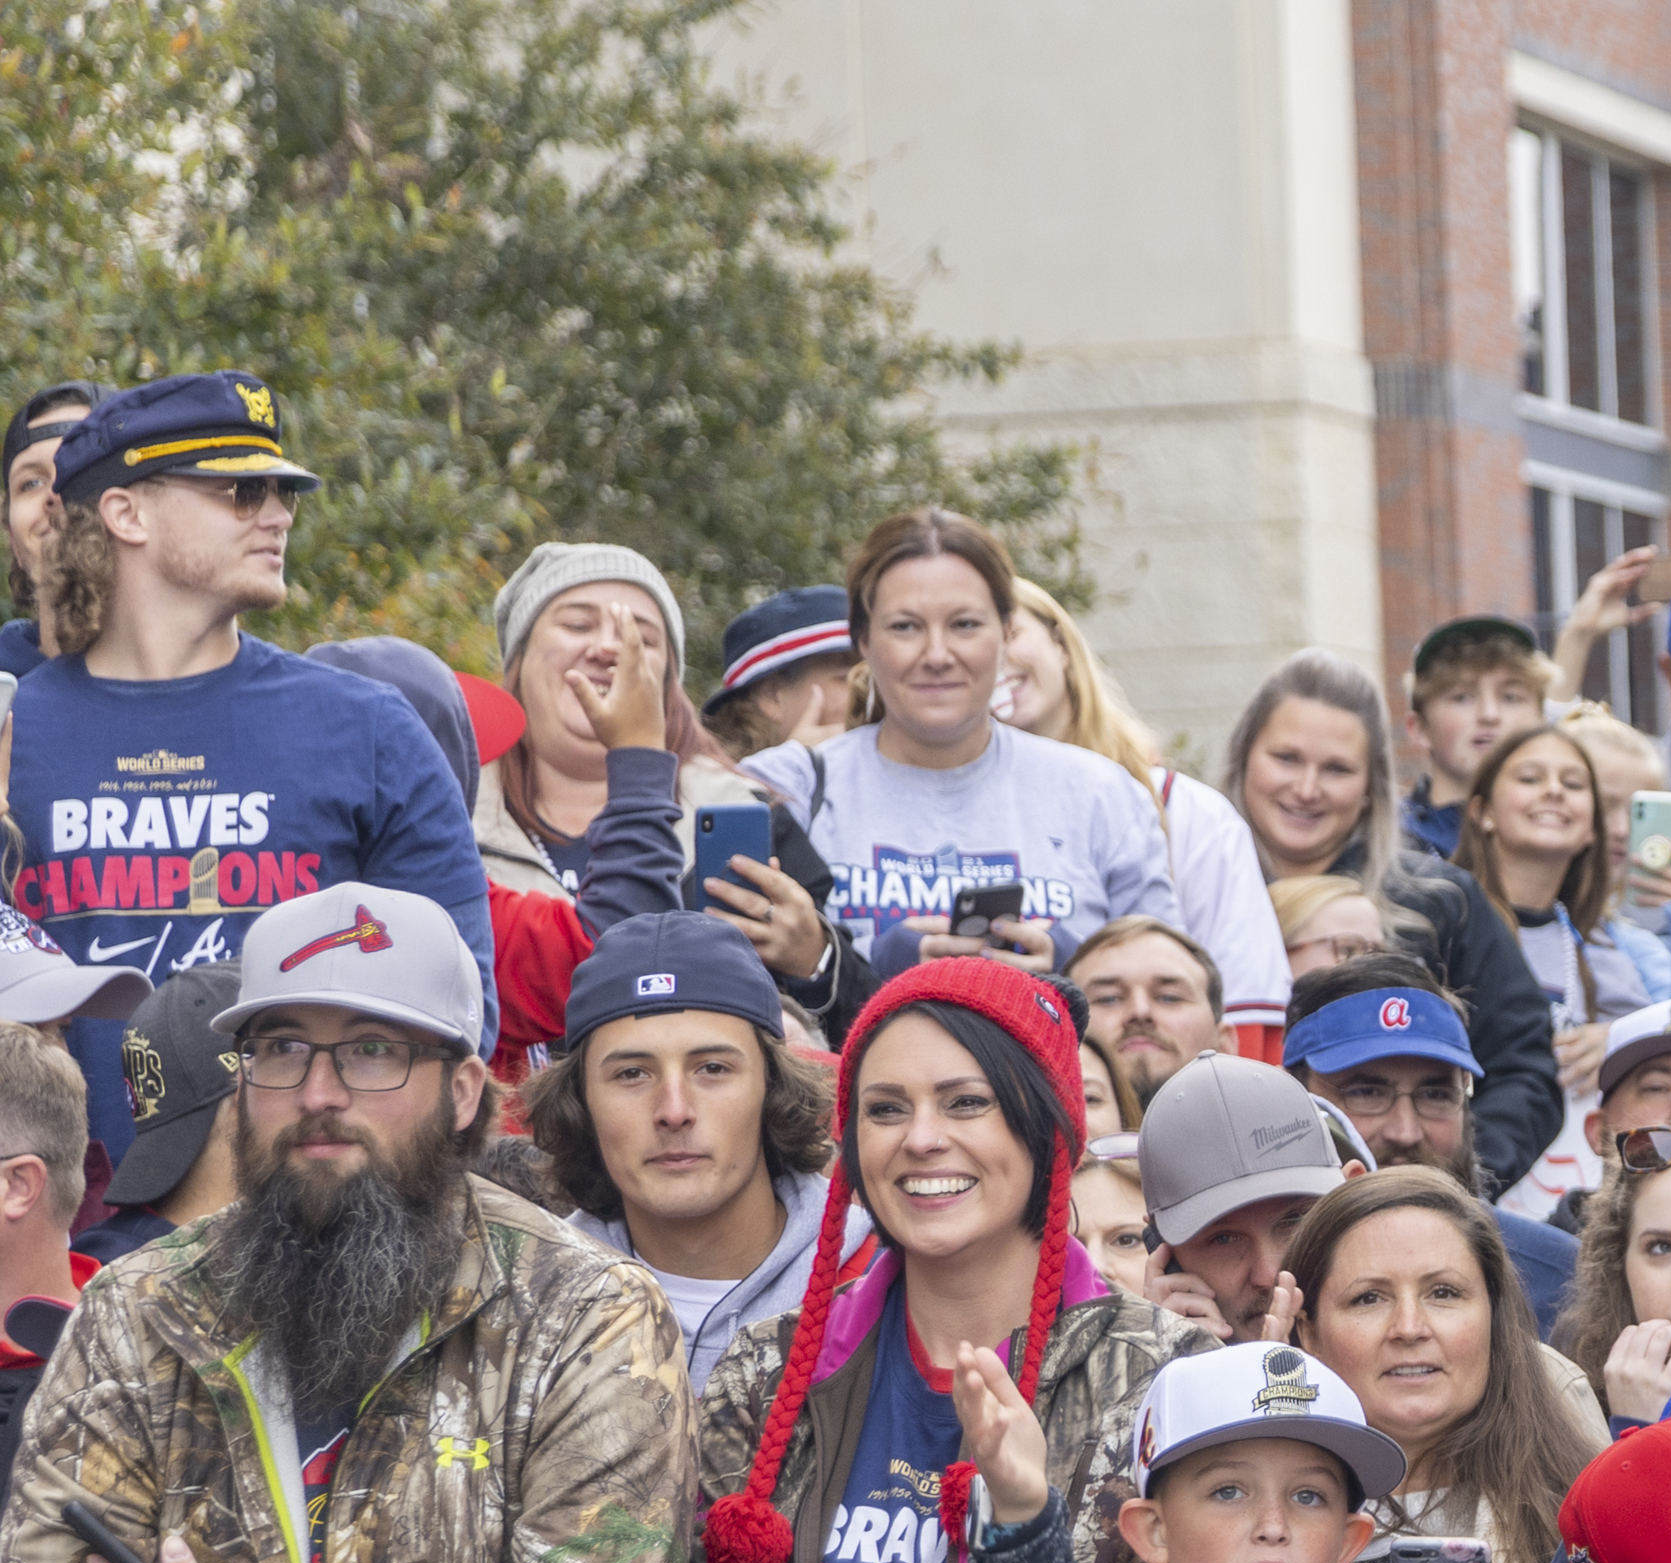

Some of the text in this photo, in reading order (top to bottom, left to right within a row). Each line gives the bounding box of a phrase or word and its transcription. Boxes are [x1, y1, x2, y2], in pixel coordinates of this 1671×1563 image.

[117, 756, 161, 772] WORLD
[162, 755, 206, 771] SERIES
[53, 792, 270, 853] BRAVES
[880, 858, 1014, 879] WORLD SERIES
[827, 864, 1073, 917] CHAMNS
[1379, 997, 1411, 1033] a
[1249, 1117, 1312, 1150] Milwaukee
[1262, 1385, 1314, 1400] CHAMPIONS
